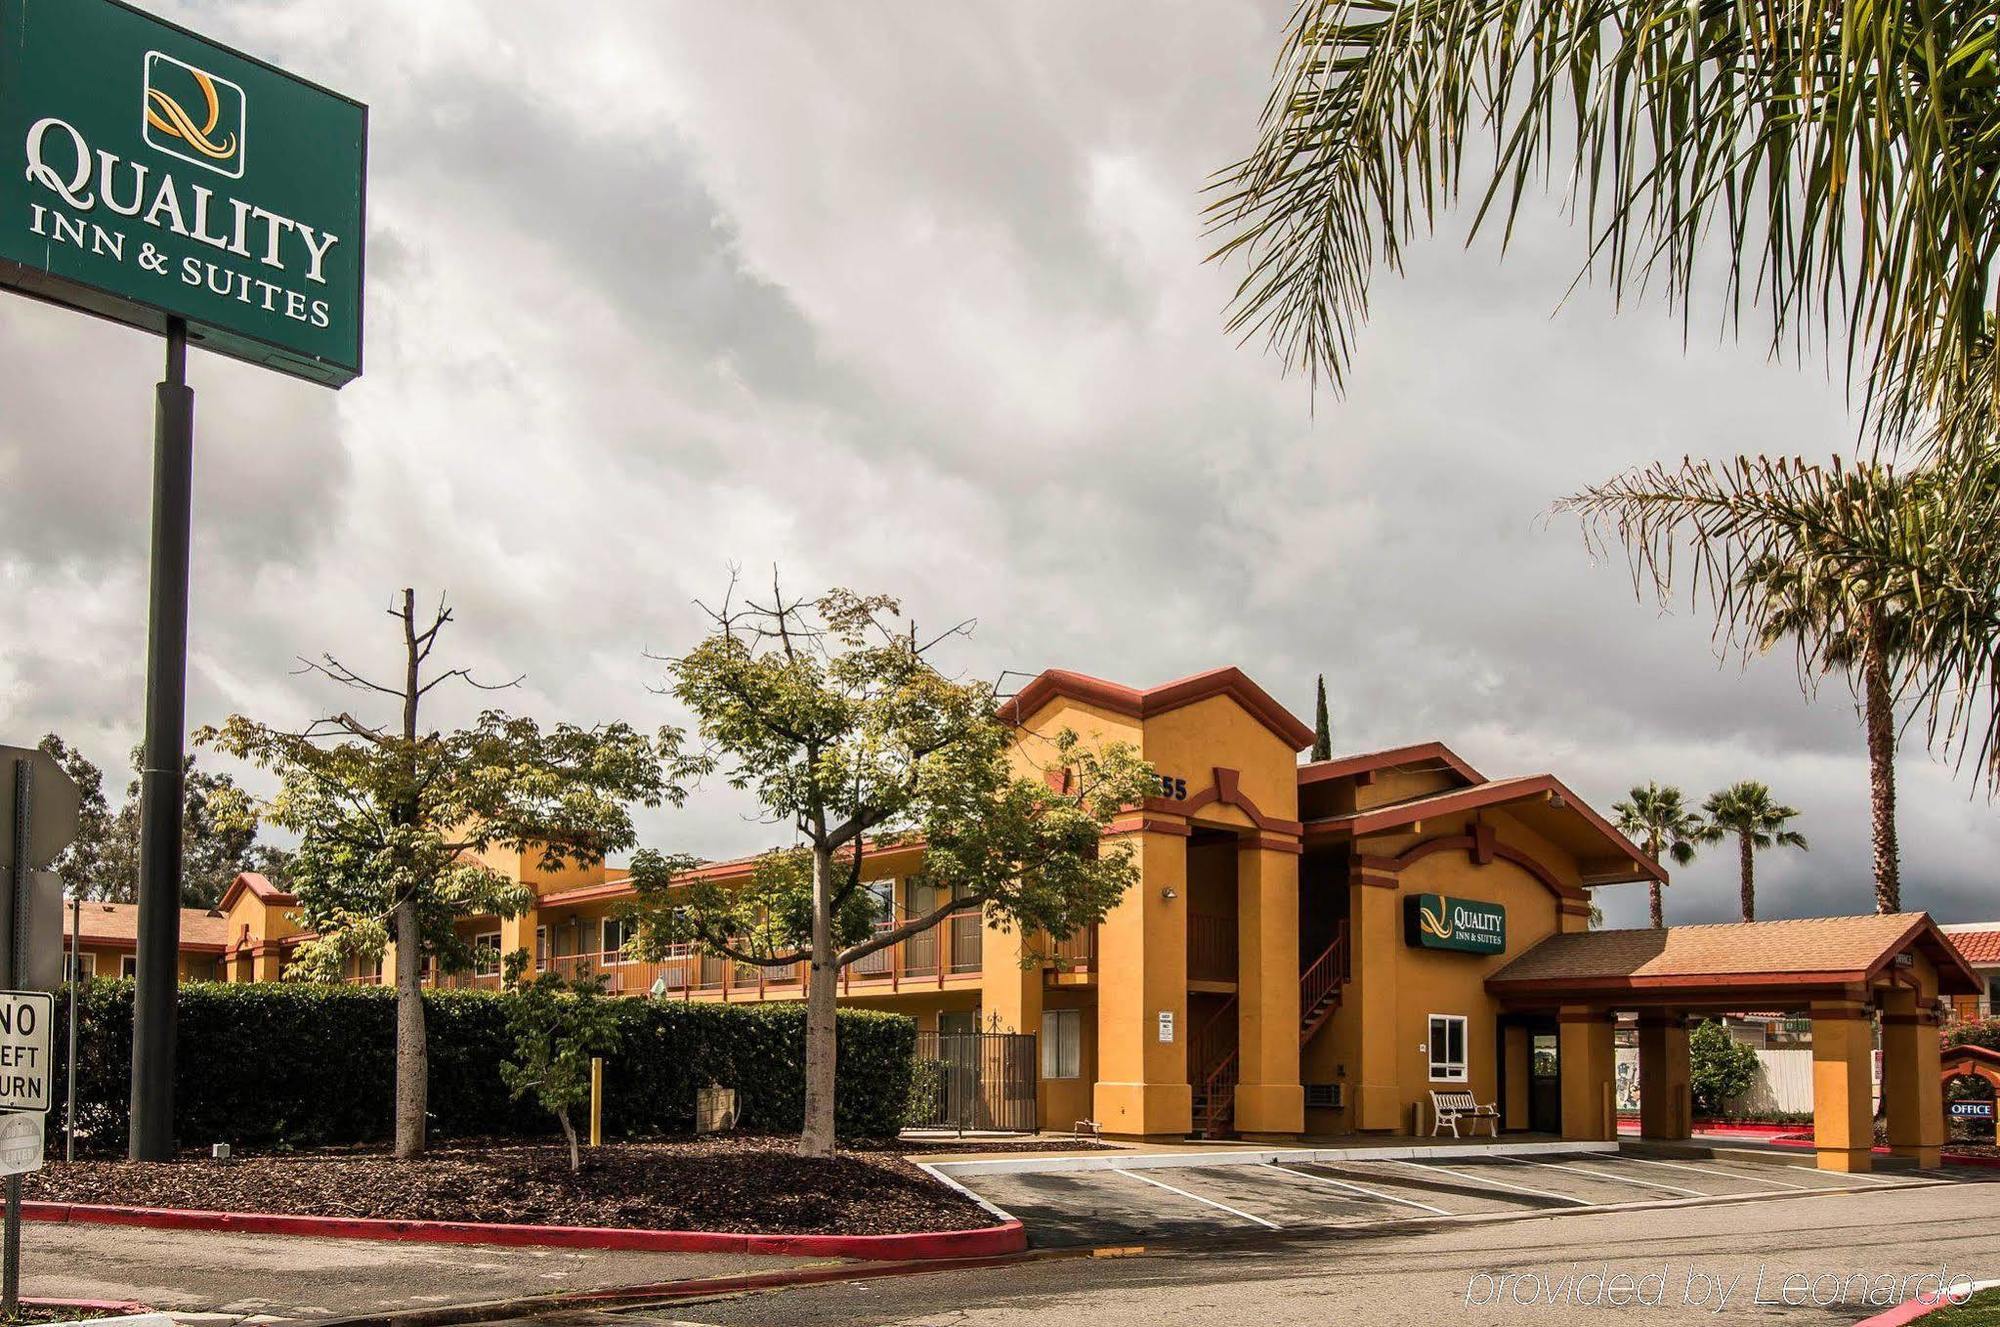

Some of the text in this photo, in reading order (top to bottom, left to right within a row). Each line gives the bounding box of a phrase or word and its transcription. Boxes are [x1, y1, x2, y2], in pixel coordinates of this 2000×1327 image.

[26, 117, 339, 284] QUALITY
[30, 203, 330, 328] INN & SUITES
[1454, 906, 1502, 931] QUALITY
[1455, 931, 1502, 945] INN & SUITES
[0, 1004, 36, 1036] NO
[0, 1045, 39, 1068] EFT
[0, 1075, 41, 1099] URN
[1951, 1104, 1991, 1115] OFFICE
